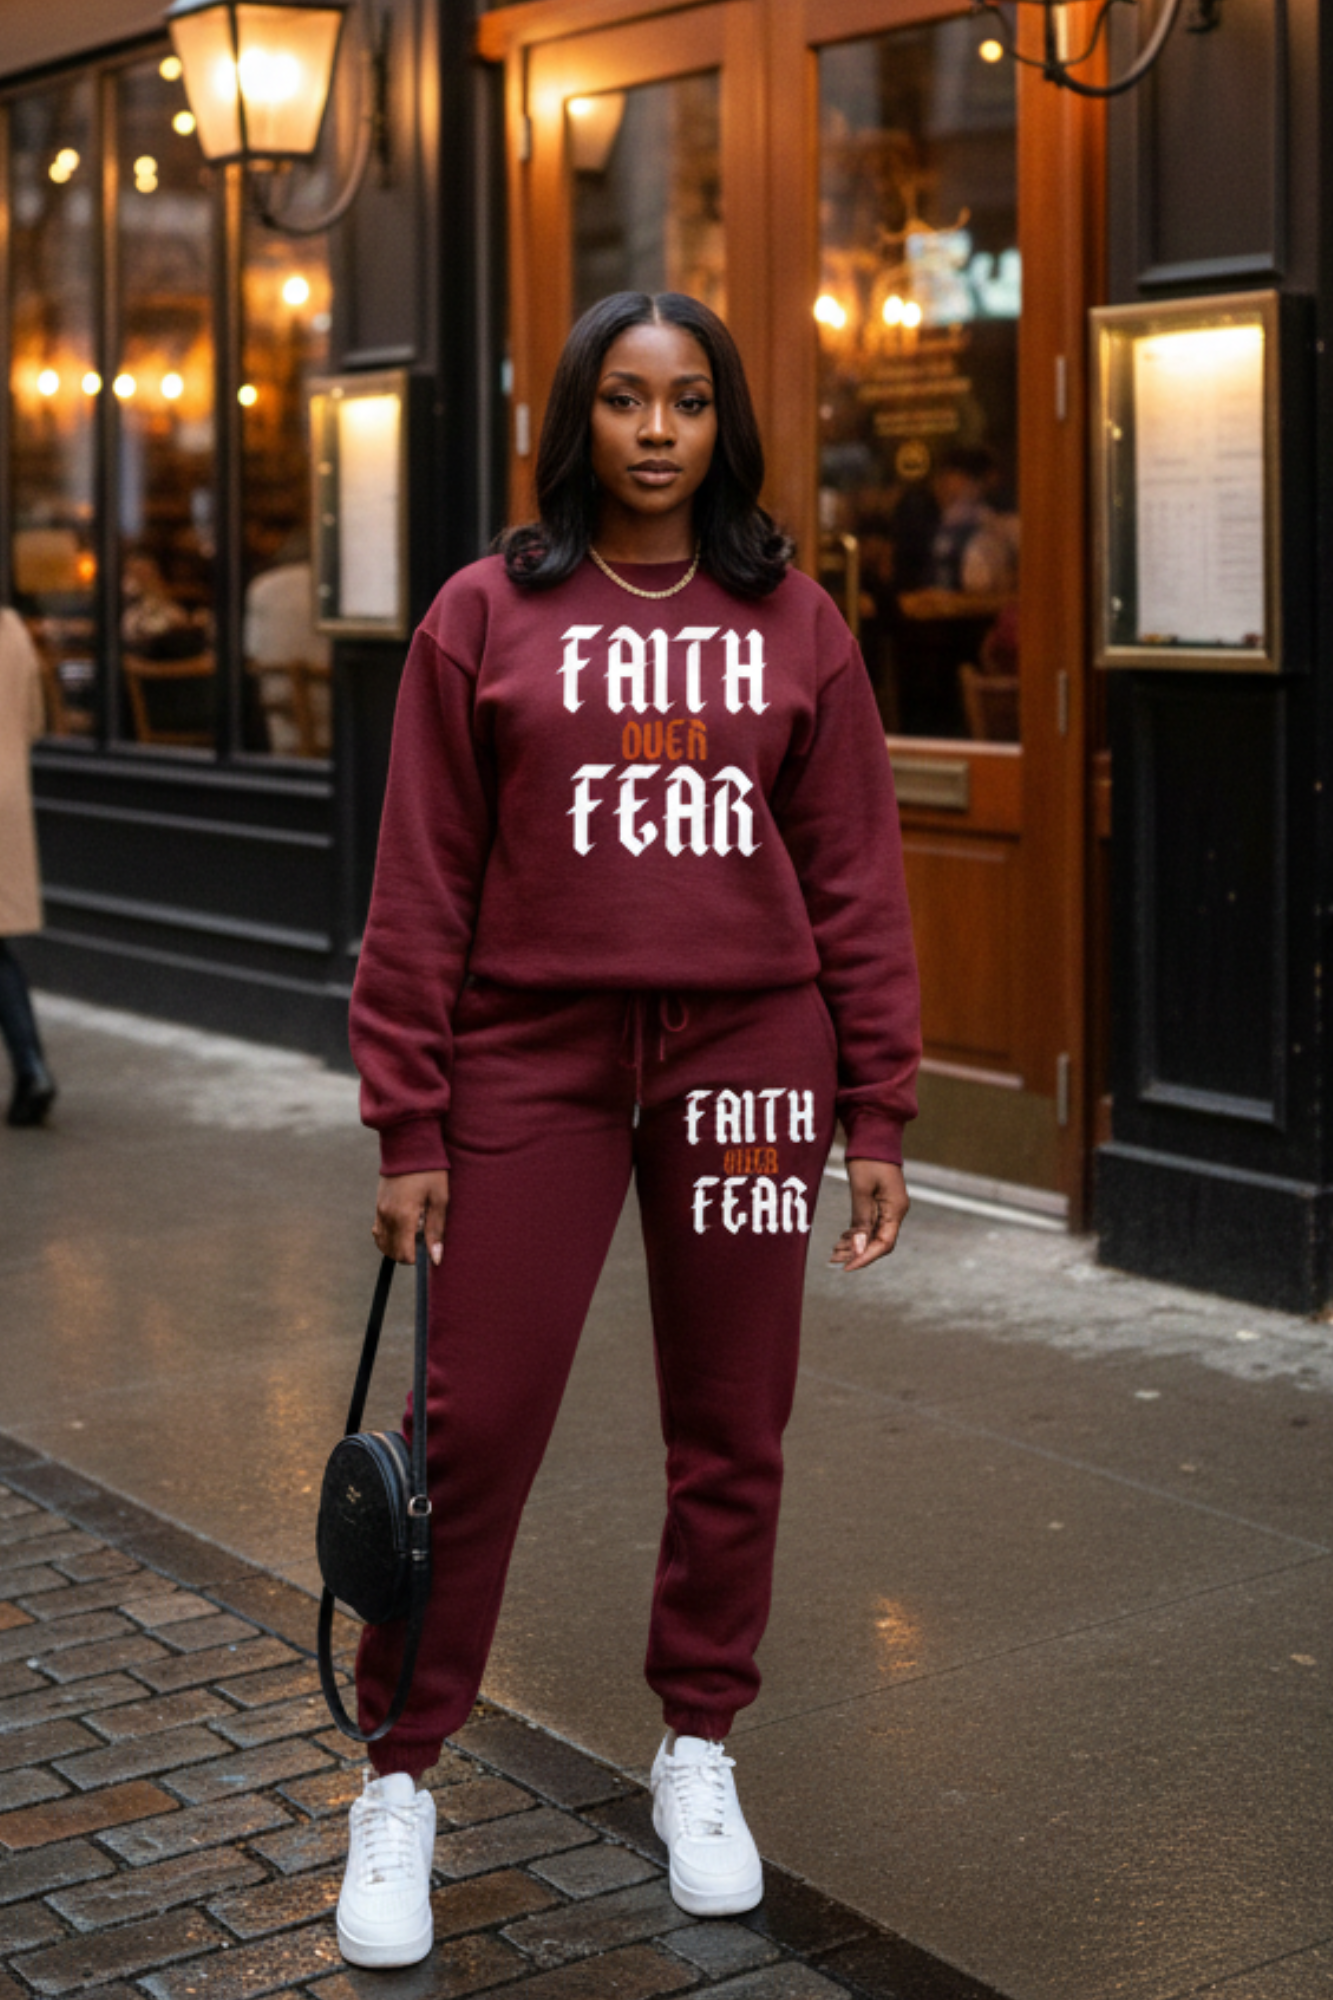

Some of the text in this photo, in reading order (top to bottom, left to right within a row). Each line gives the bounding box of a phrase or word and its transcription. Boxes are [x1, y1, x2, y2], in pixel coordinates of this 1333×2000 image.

[557, 625, 770, 715] FAITH
[566, 764, 763, 857] FEAR
[684, 1088, 816, 1145] FAITH
[691, 1175, 811, 1234] FEAR
